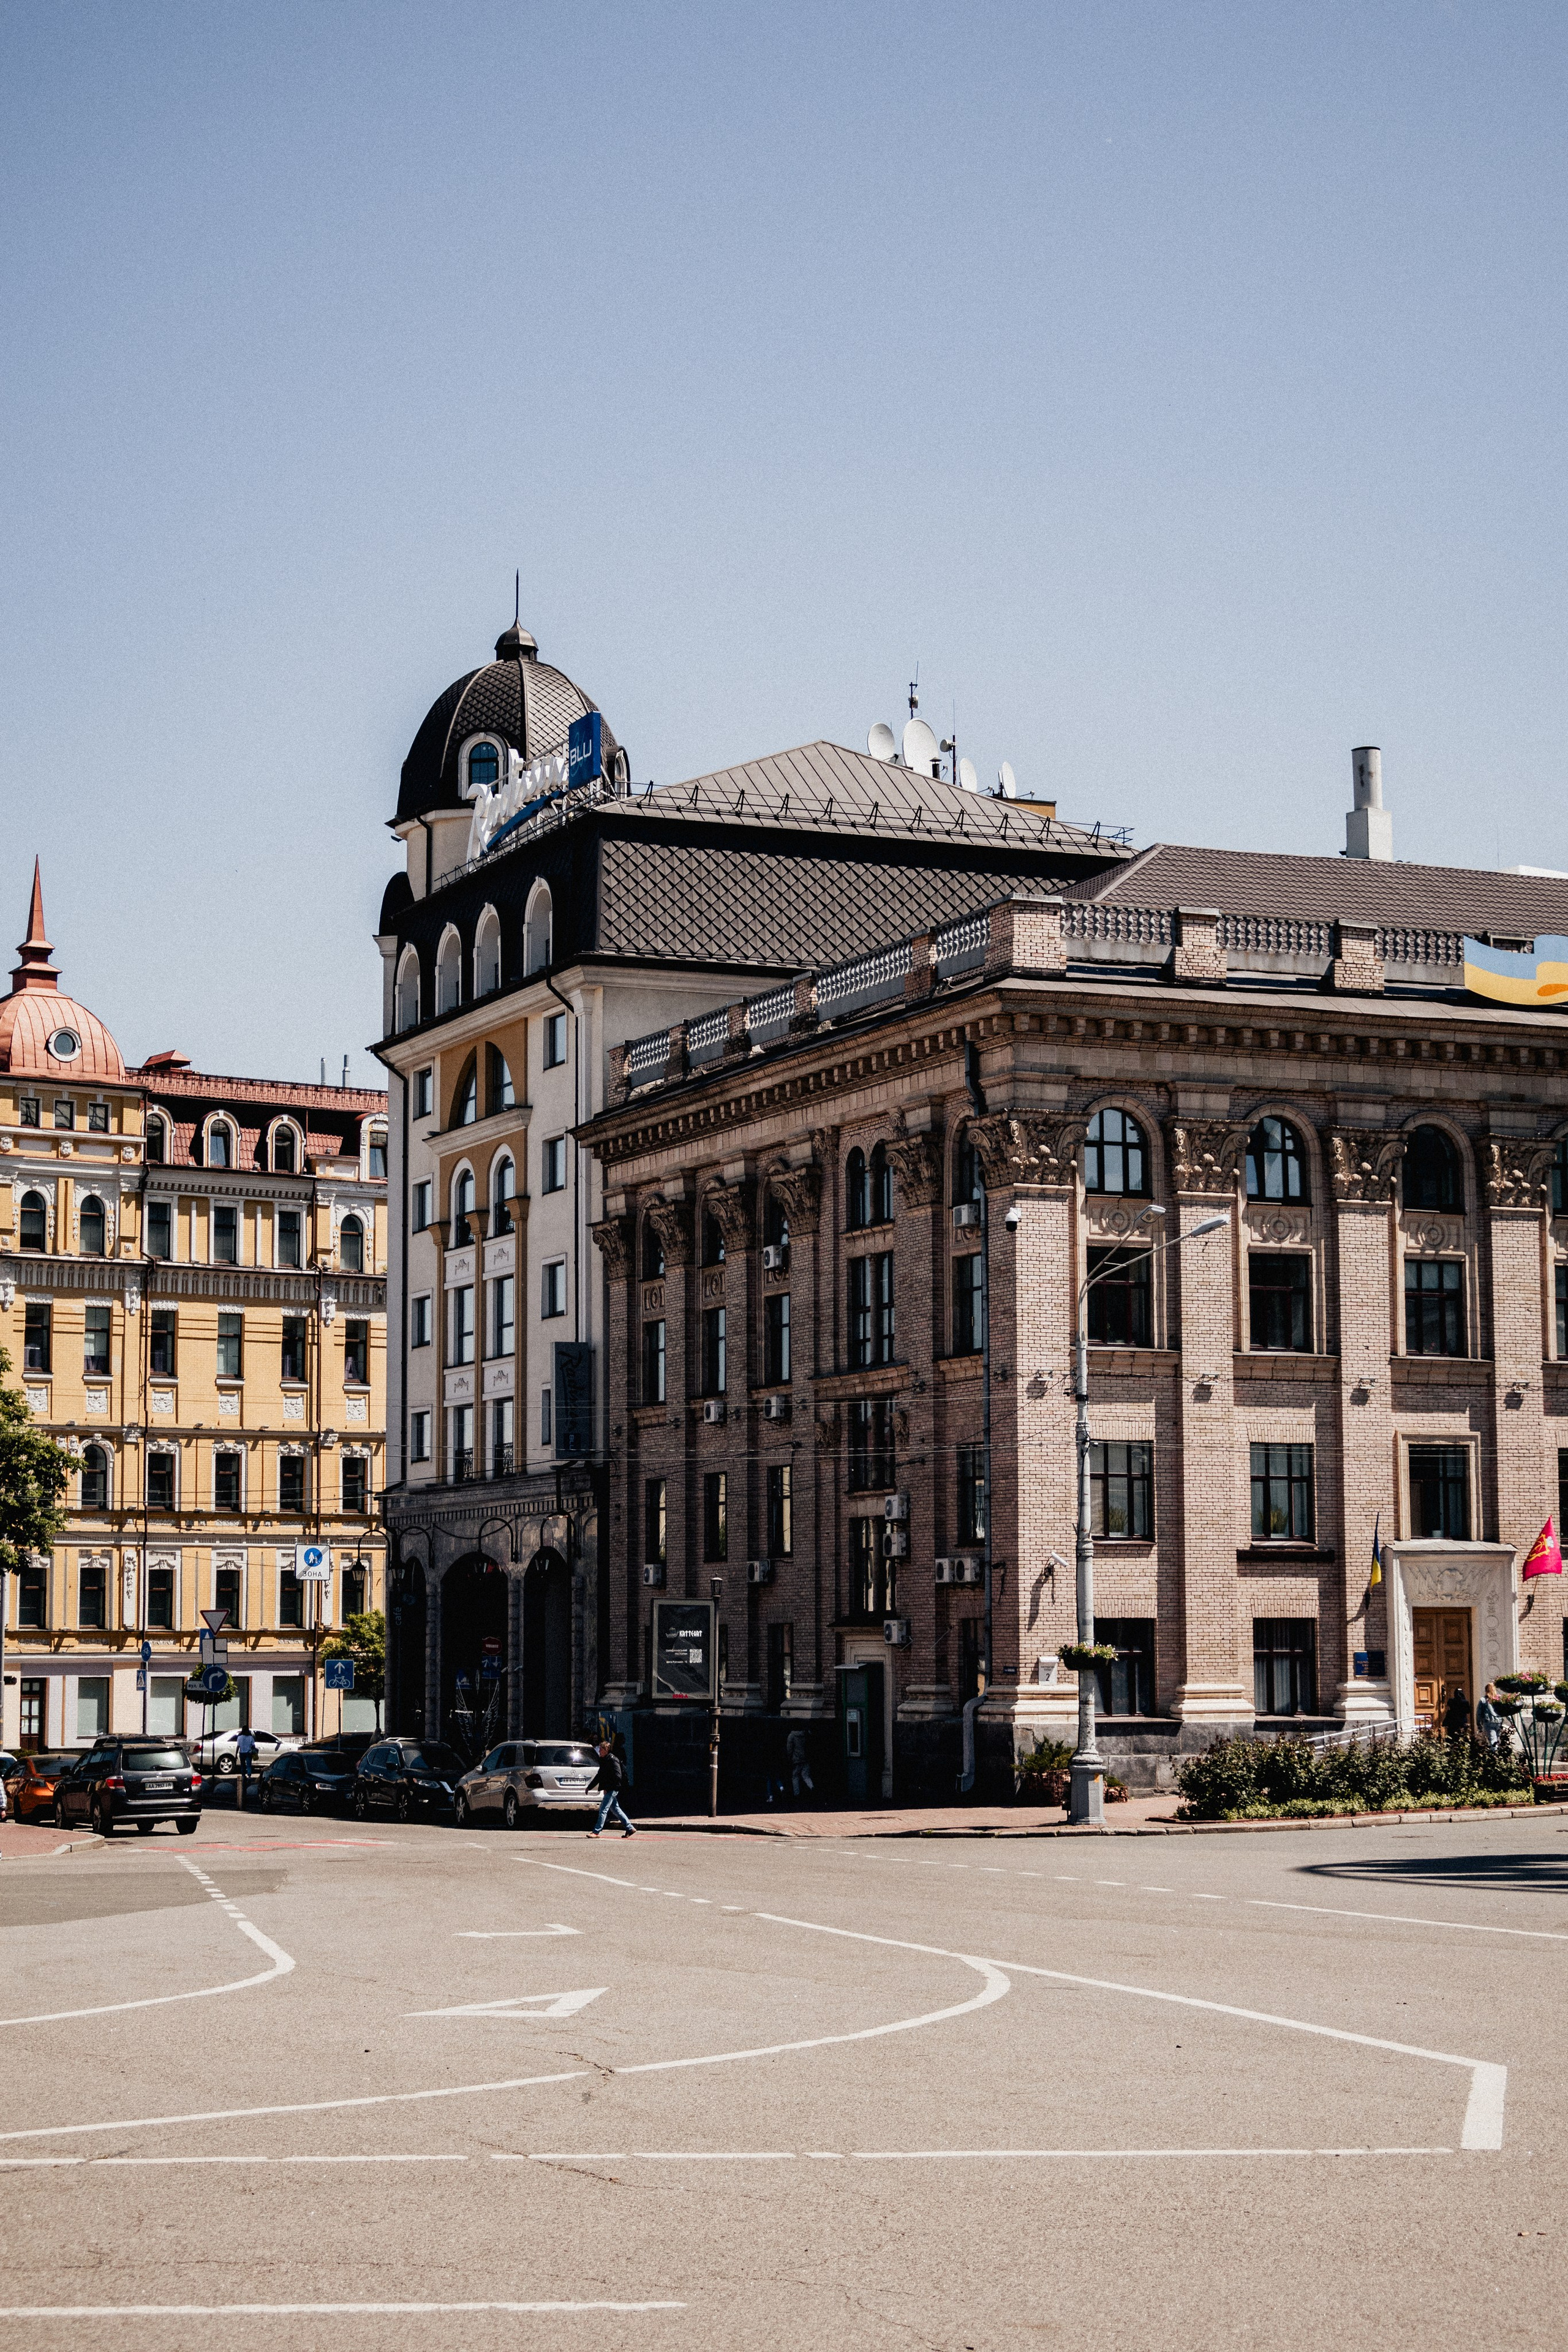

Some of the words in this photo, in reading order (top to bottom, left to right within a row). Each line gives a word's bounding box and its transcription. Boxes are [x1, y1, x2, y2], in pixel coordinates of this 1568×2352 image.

[570, 739, 592, 767] BLU
[393, 1607, 402, 1626] café
[1046, 1673, 1050, 1681] 2
